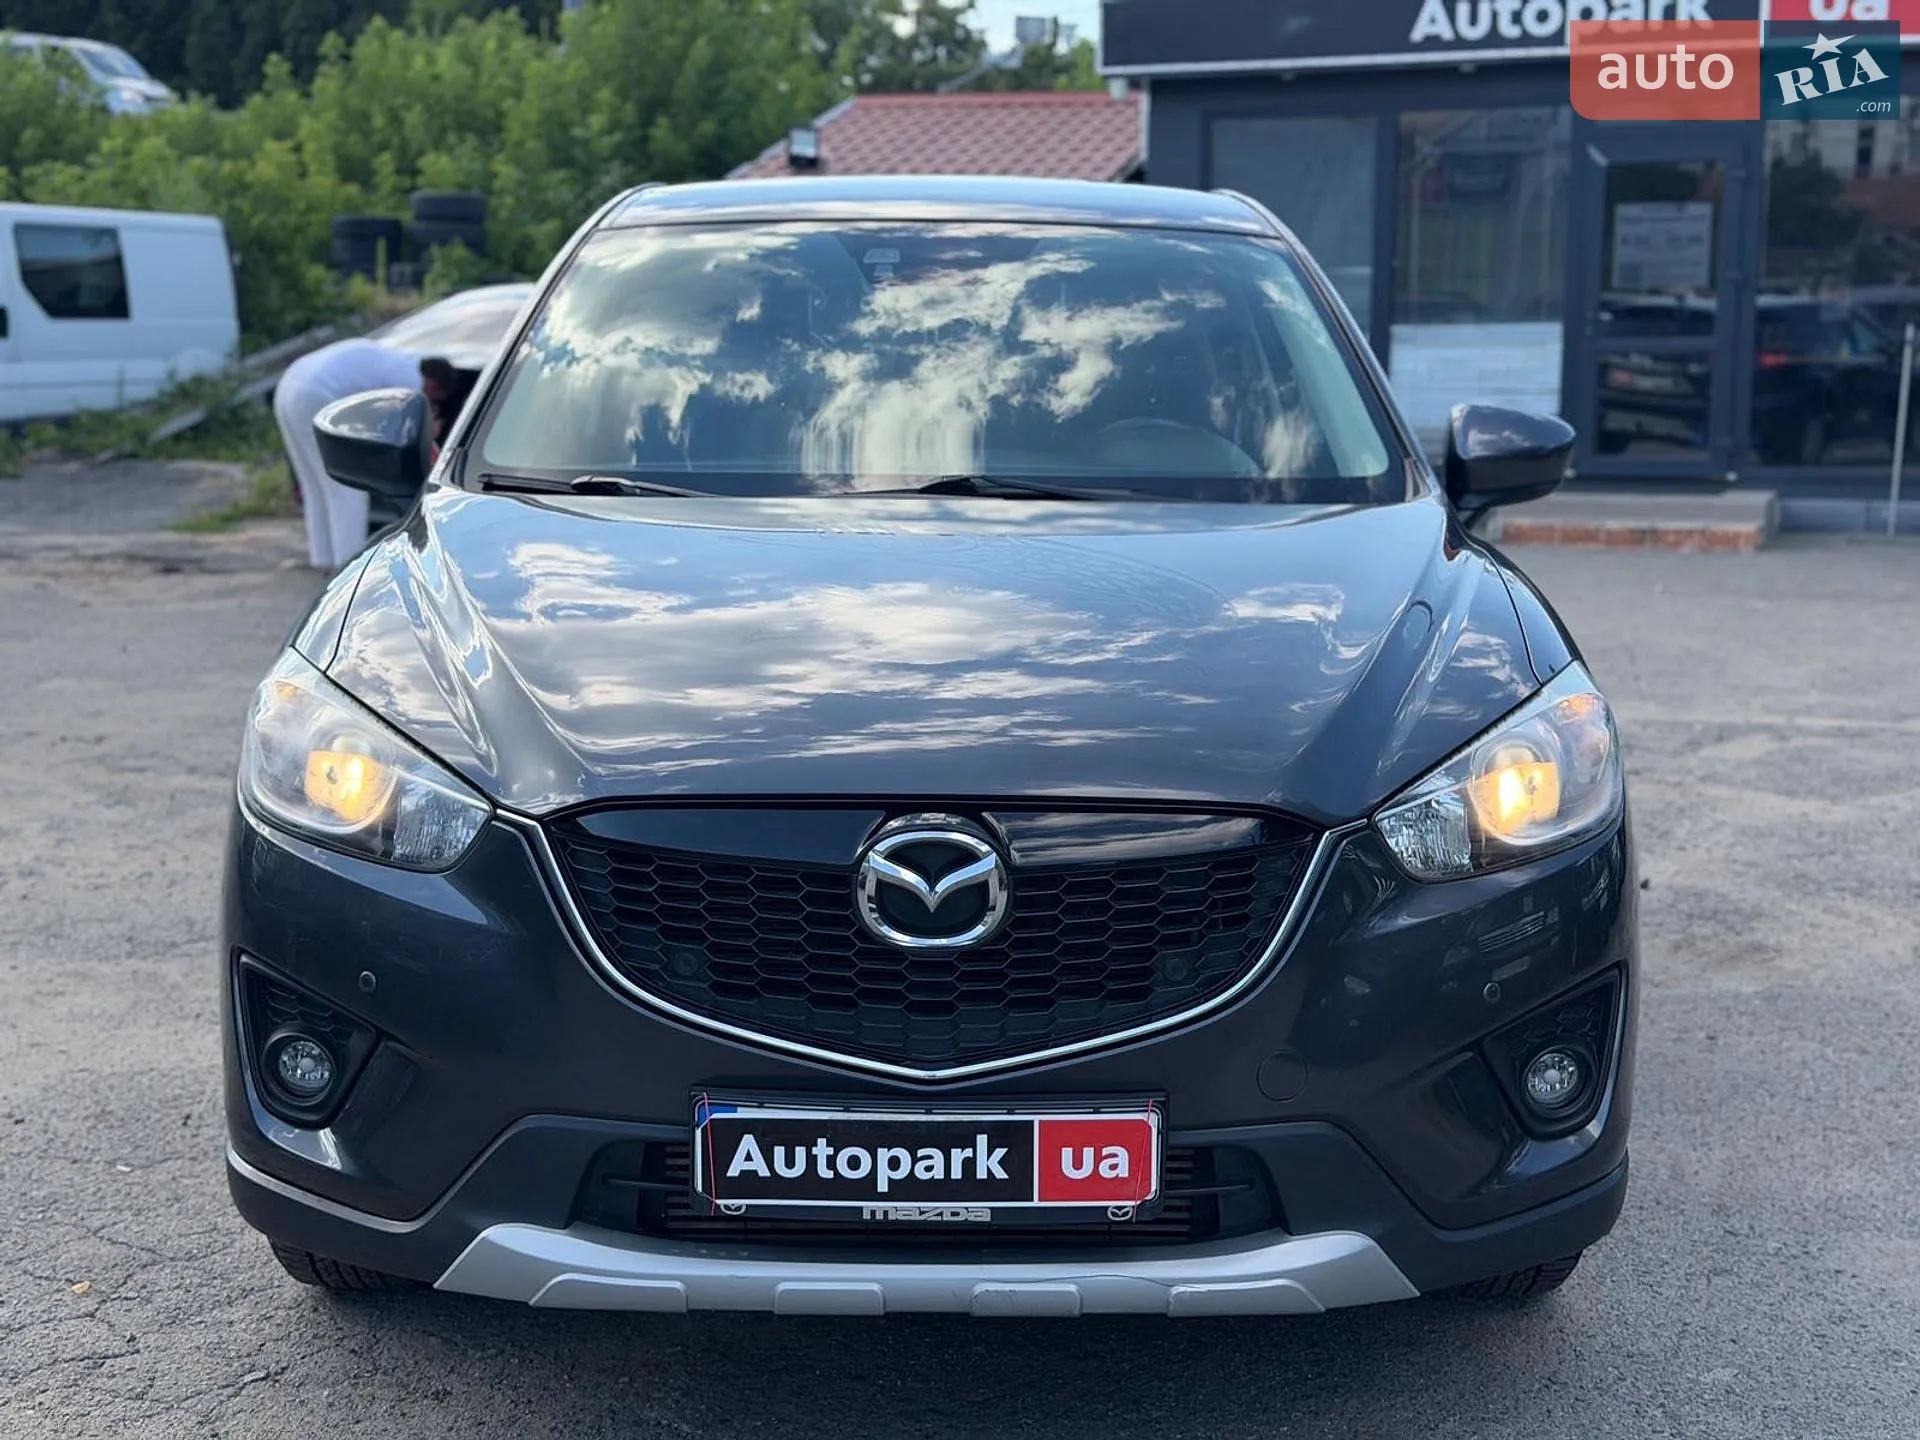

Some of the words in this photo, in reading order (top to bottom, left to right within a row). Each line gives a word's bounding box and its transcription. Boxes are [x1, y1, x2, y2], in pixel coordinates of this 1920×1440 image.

[1409, 0, 1715, 46] Autopark
[726, 1134, 1009, 1192] Autopark
[1061, 1145, 1129, 1179] ua
